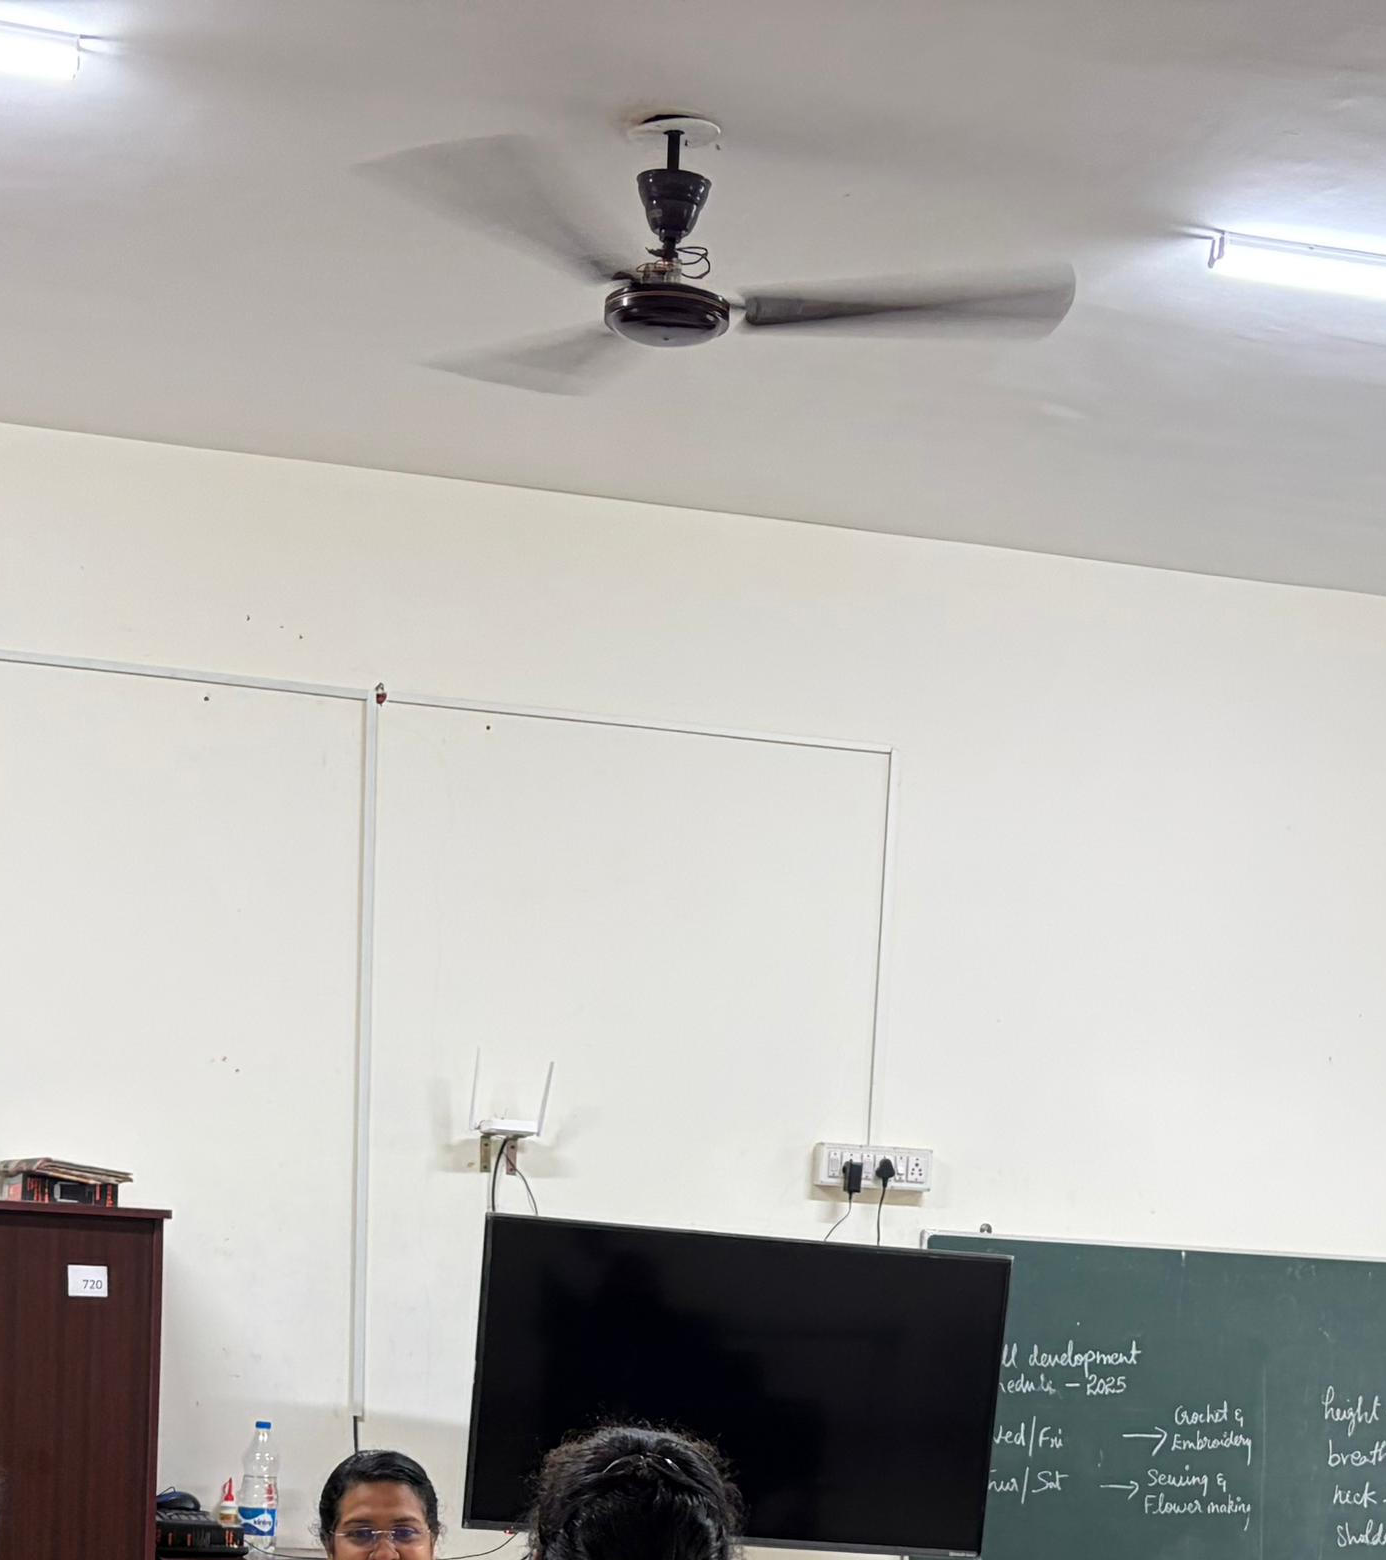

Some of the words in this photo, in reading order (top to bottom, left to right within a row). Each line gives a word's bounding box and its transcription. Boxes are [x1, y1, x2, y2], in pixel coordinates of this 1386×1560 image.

[82, 1279, 103, 1290] 720
[1028, 1339, 1142, 1378] development
[1086, 1374, 1127, 1396] 2025
[1175, 1400, 1228, 1425] Crochet
[1321, 1385, 1381, 1437] height
[1171, 1430, 1253, 1466] Embroidery
[1147, 1464, 1209, 1497] Sewing
[1144, 1492, 1203, 1515] Flower
[1207, 1494, 1252, 1532] making
